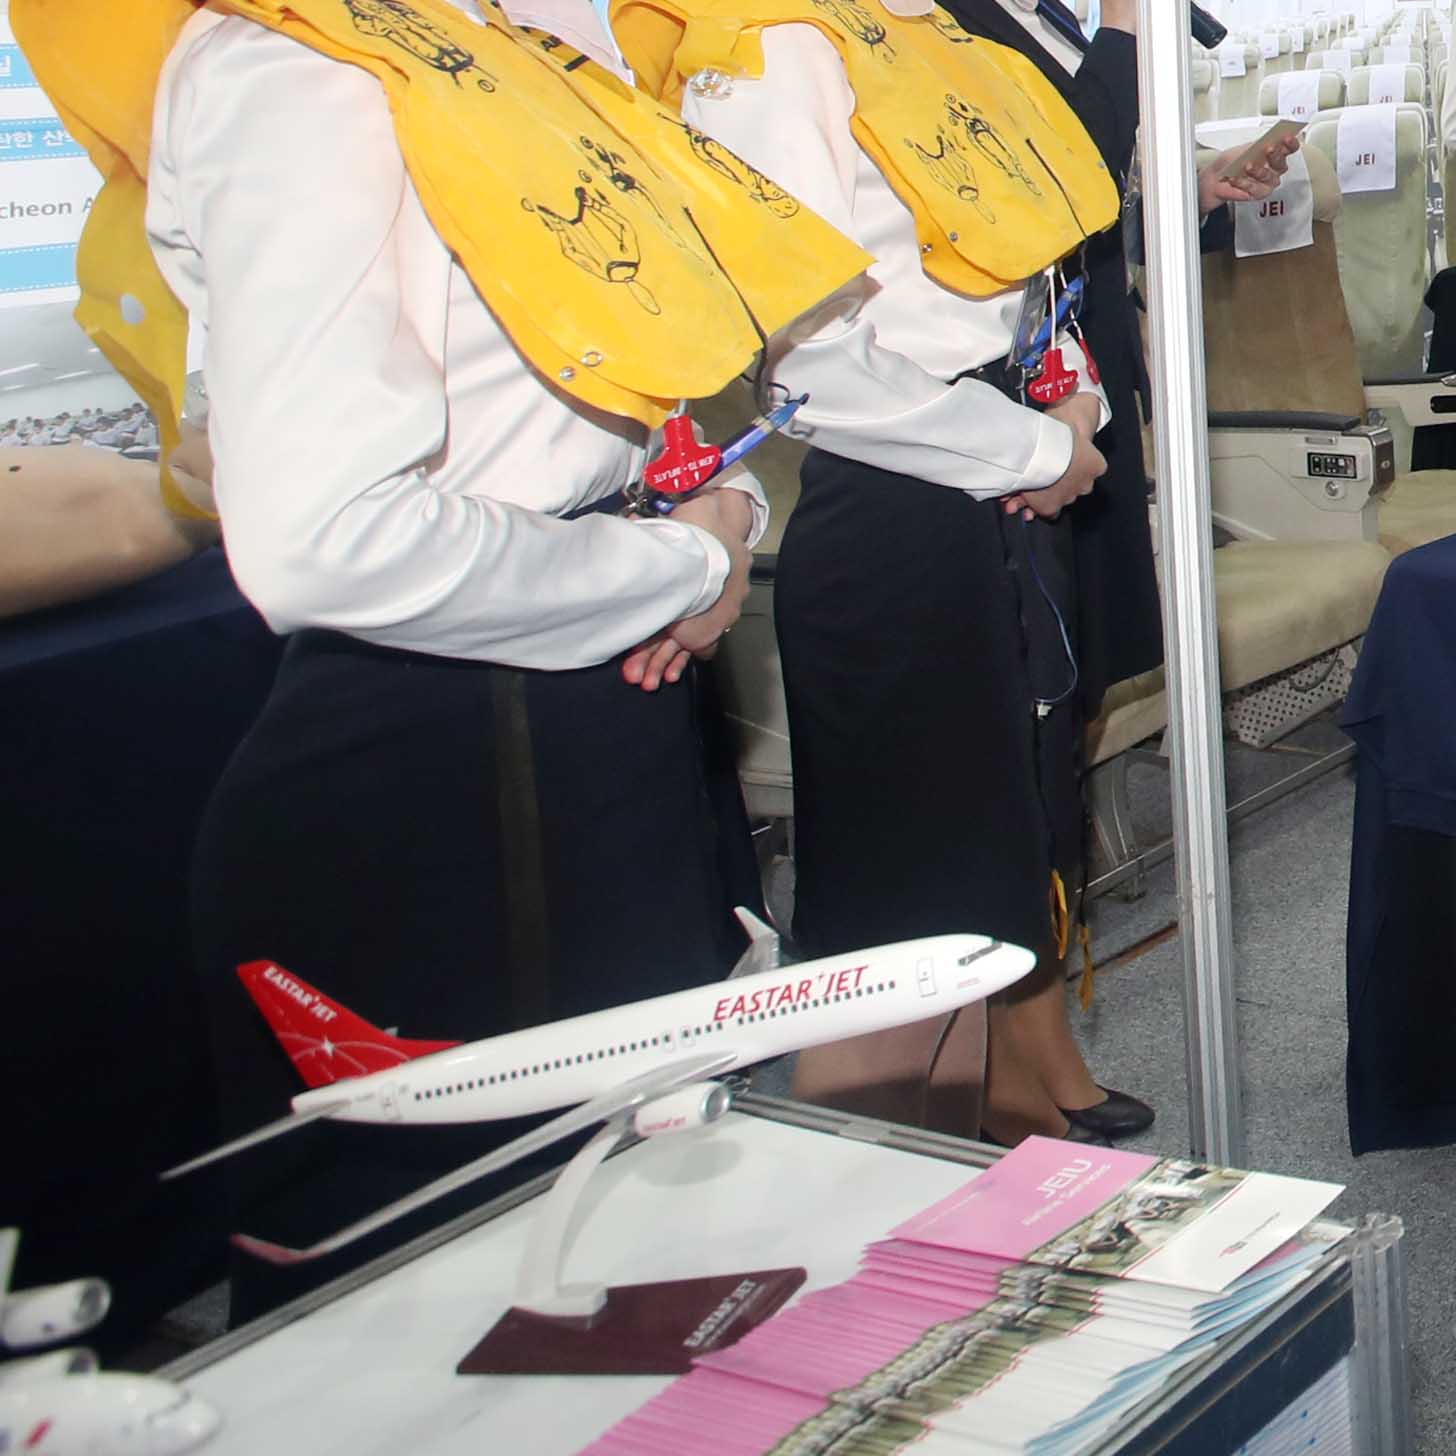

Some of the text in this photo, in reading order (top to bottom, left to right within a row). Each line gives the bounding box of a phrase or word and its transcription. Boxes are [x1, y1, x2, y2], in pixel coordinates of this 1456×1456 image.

[1355, 153, 1376, 166] JEI
[1259, 199, 1284, 218] JEI
[263, 964, 314, 1007] EASTAR
[713, 965, 869, 1022] EASTAR JET
[1036, 1158, 1093, 1199] JEIU
